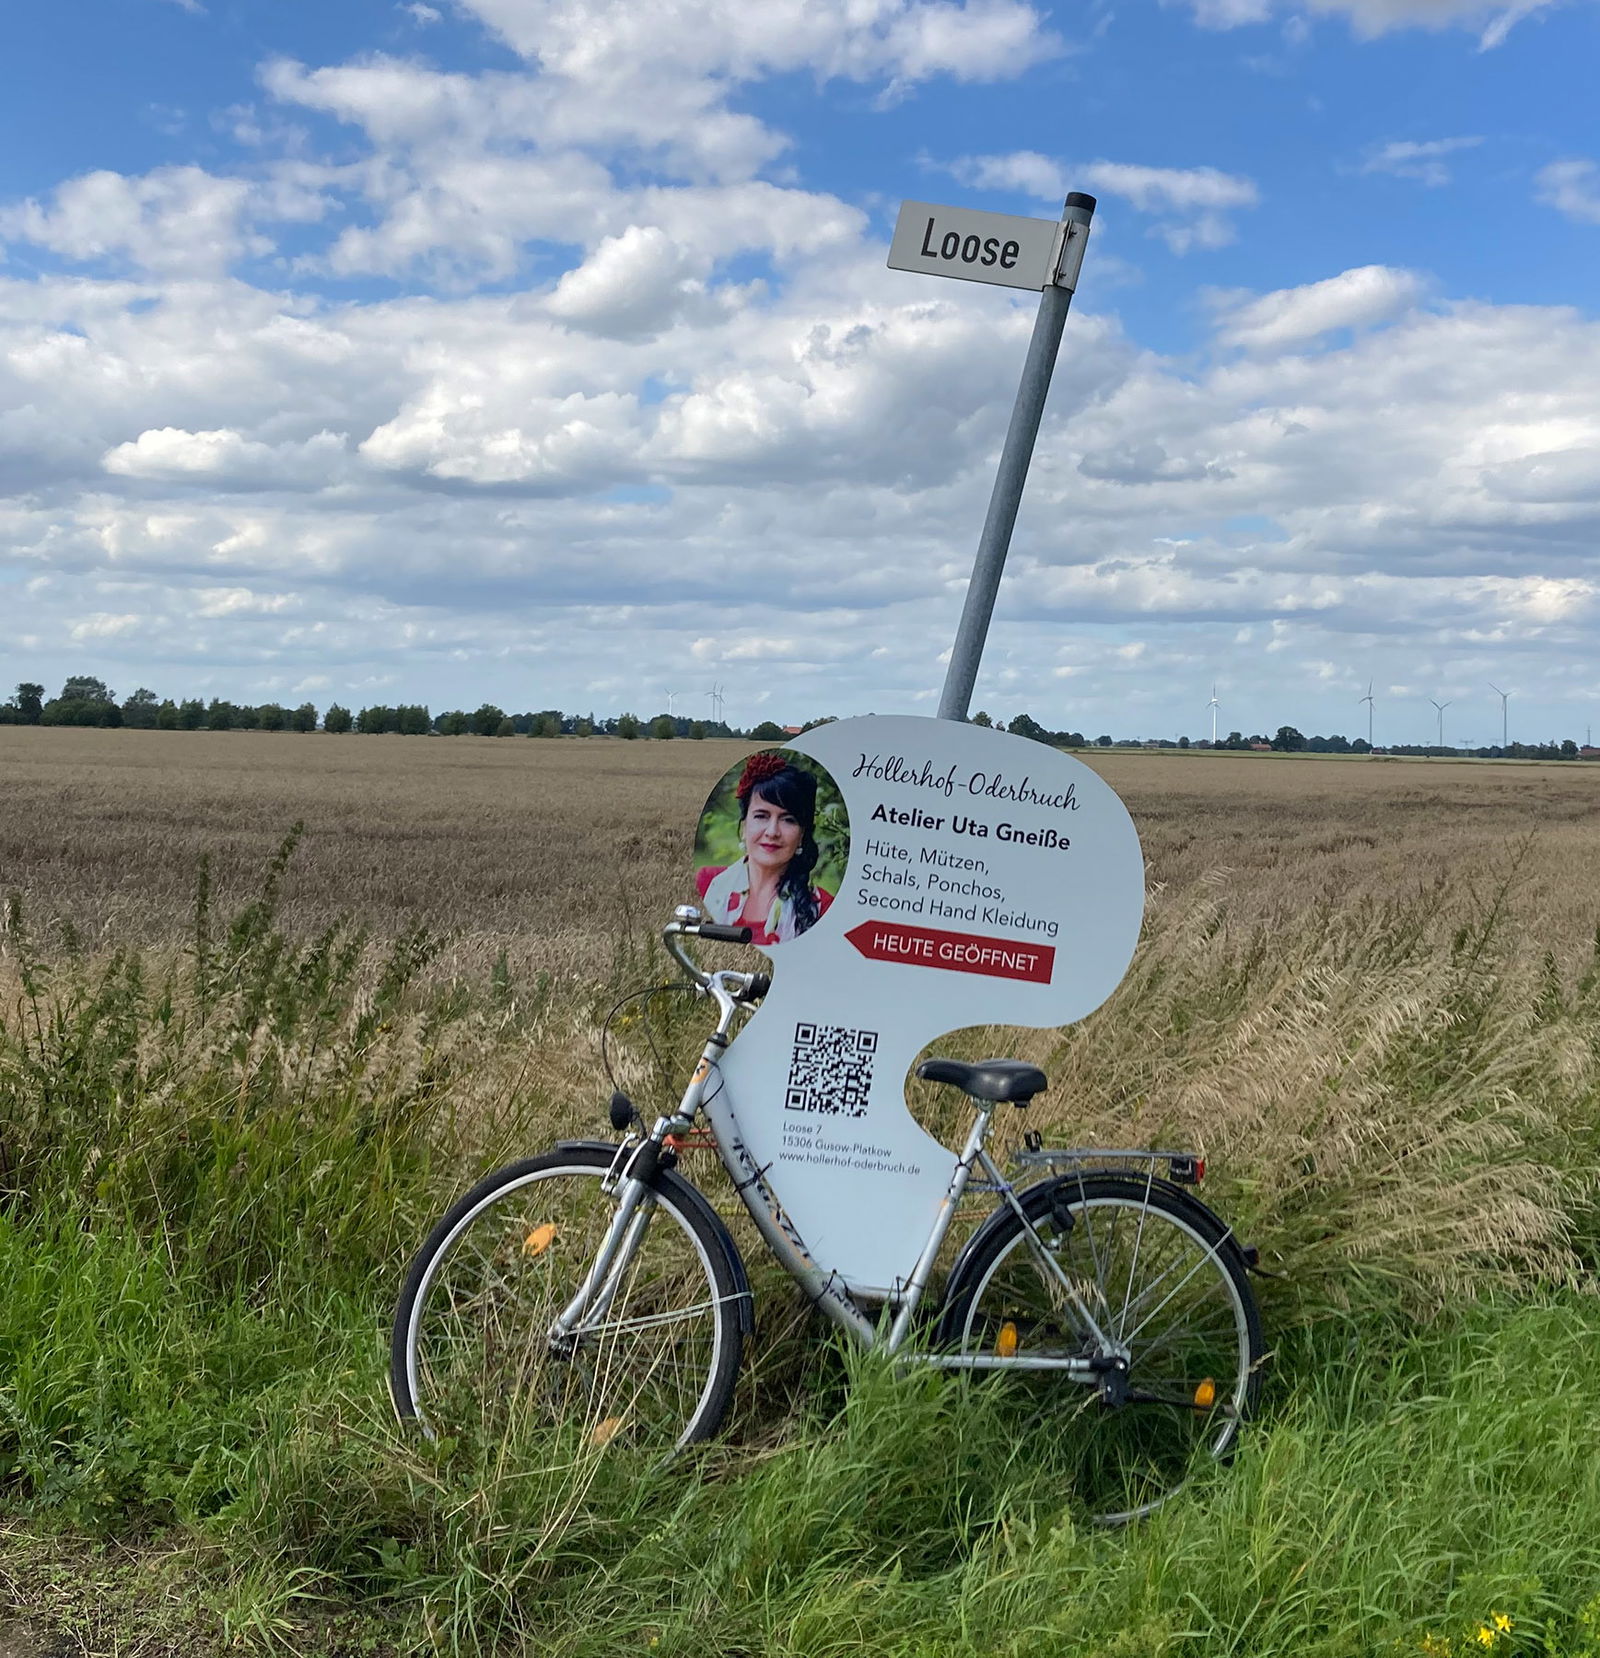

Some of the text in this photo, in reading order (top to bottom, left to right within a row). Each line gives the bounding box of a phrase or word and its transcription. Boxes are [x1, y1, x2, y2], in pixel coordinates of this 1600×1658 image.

[921, 217, 1020, 269] Loose
[852, 753, 1081, 811] Hollerhof-Oderbruch
[871, 803, 1071, 850] Atelier Uta Gneiße
[865, 839, 990, 876] Hüte, Mützen,
[861, 864, 1006, 903] Schals, Ponchos,
[857, 888, 1059, 938] Second Hand Kleidung
[873, 932, 1039, 972] HEUTE GEÖFFNET
[782, 1135, 892, 1158] 15306 Gusow-Platkow
[783, 1120, 822, 1134] Loose 7
[779, 1151, 921, 1175] www.hollerhof-oderbruch.de
